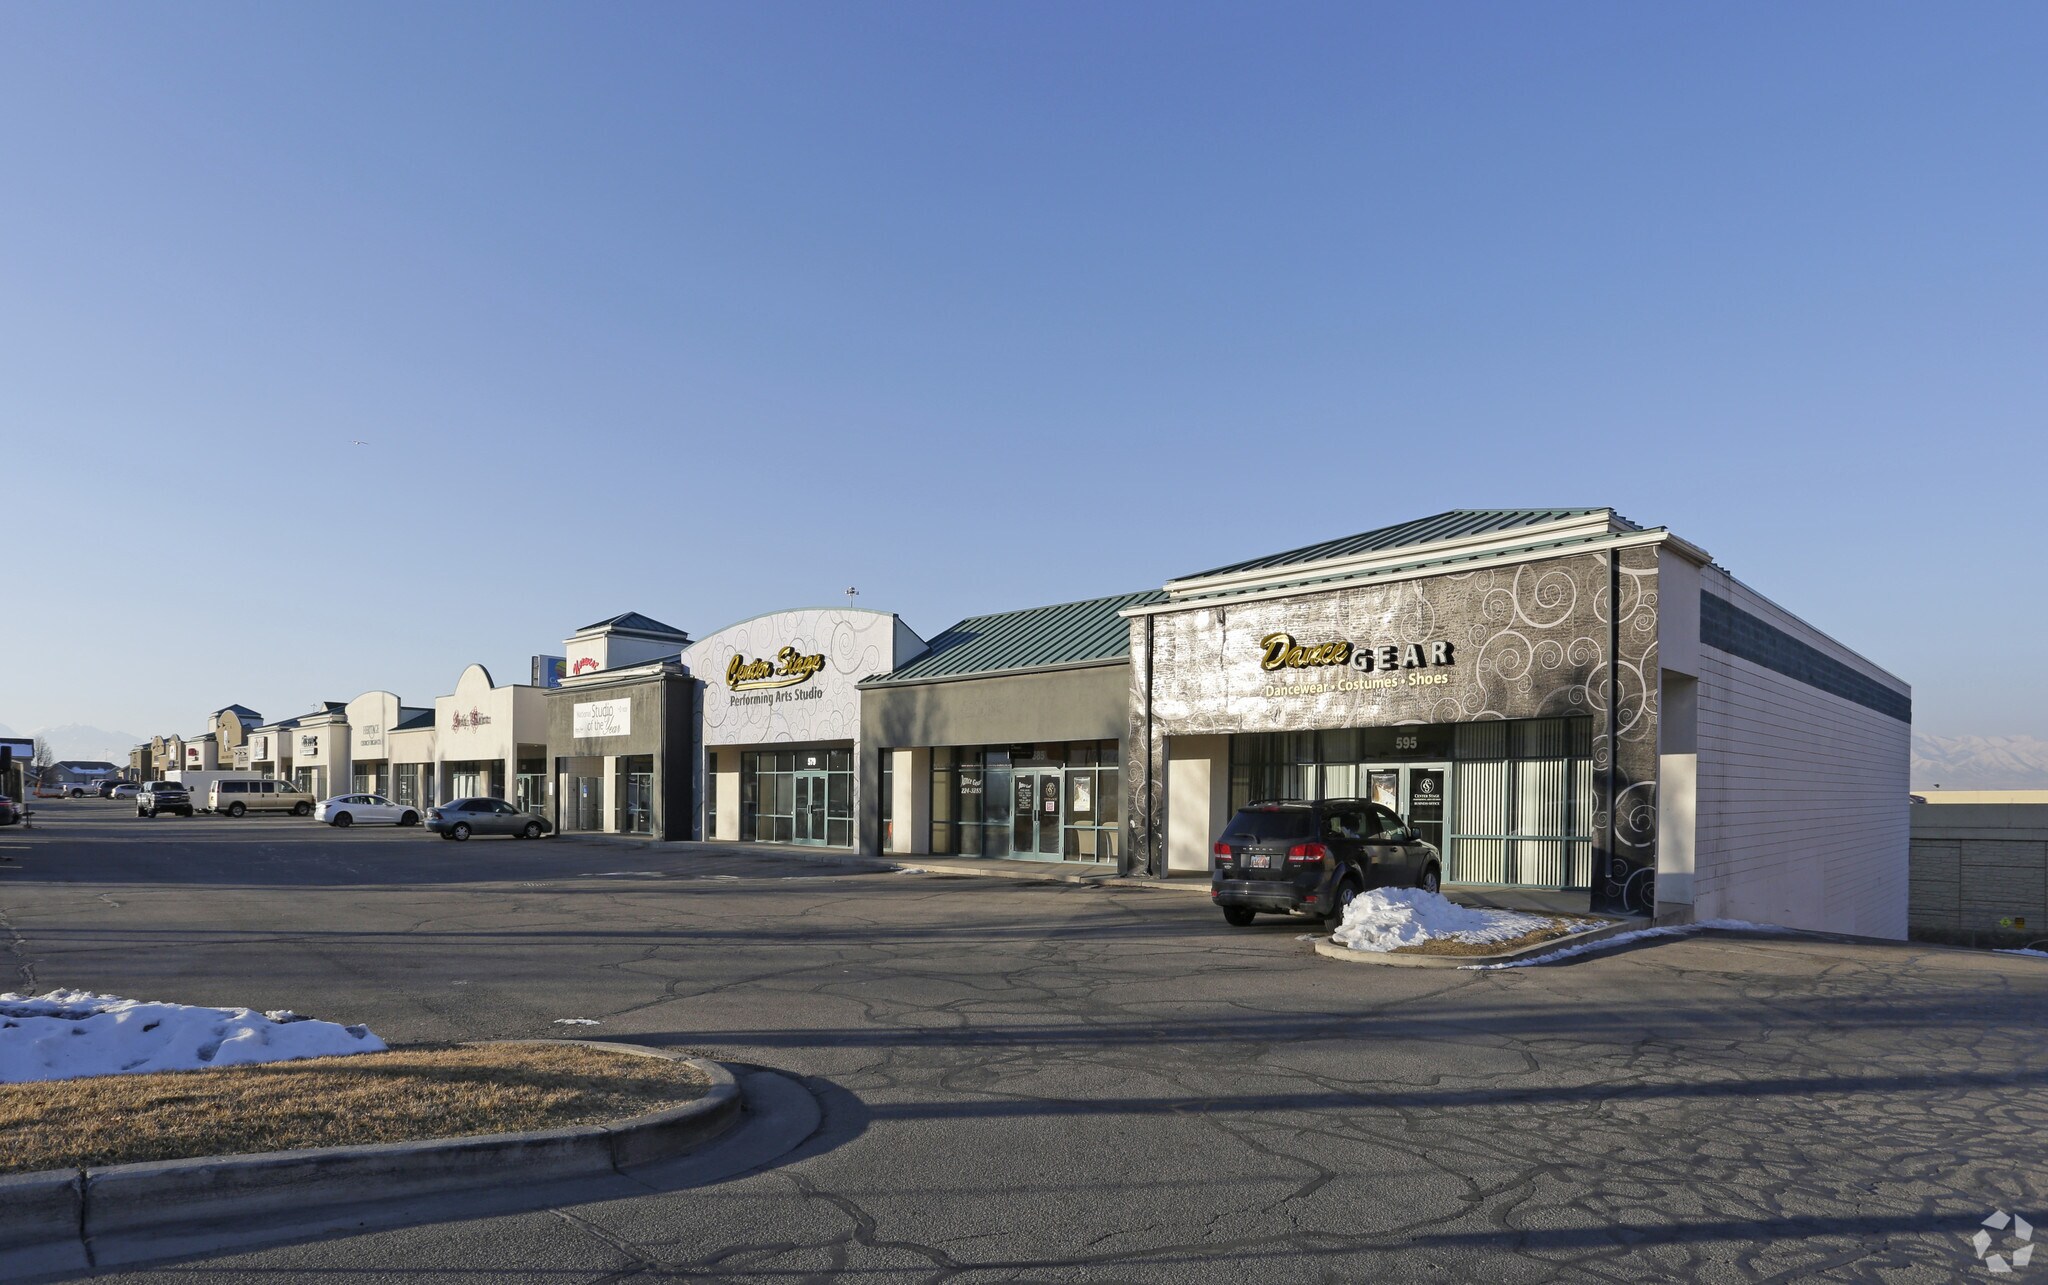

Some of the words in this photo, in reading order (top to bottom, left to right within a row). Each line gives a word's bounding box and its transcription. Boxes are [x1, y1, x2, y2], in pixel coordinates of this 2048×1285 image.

[1260, 632, 1353, 671] Dance
[1351, 641, 1455, 672] GEAR
[726, 654, 774, 686] Center
[776, 646, 825, 681] Stage
[1265, 683, 1328, 697] Dancewear
[1338, 677, 1398, 691] Costumes
[1408, 672, 1448, 686] Shoes
[730, 691, 774, 707] Performing
[775, 690, 793, 702] Arts
[795, 686, 823, 700] Studio
[591, 702, 614, 718] Studio
[587, 719, 595, 731] of
[594, 718, 604, 730] the
[603, 715, 621, 735] Year
[1396, 736, 1418, 749] 595
